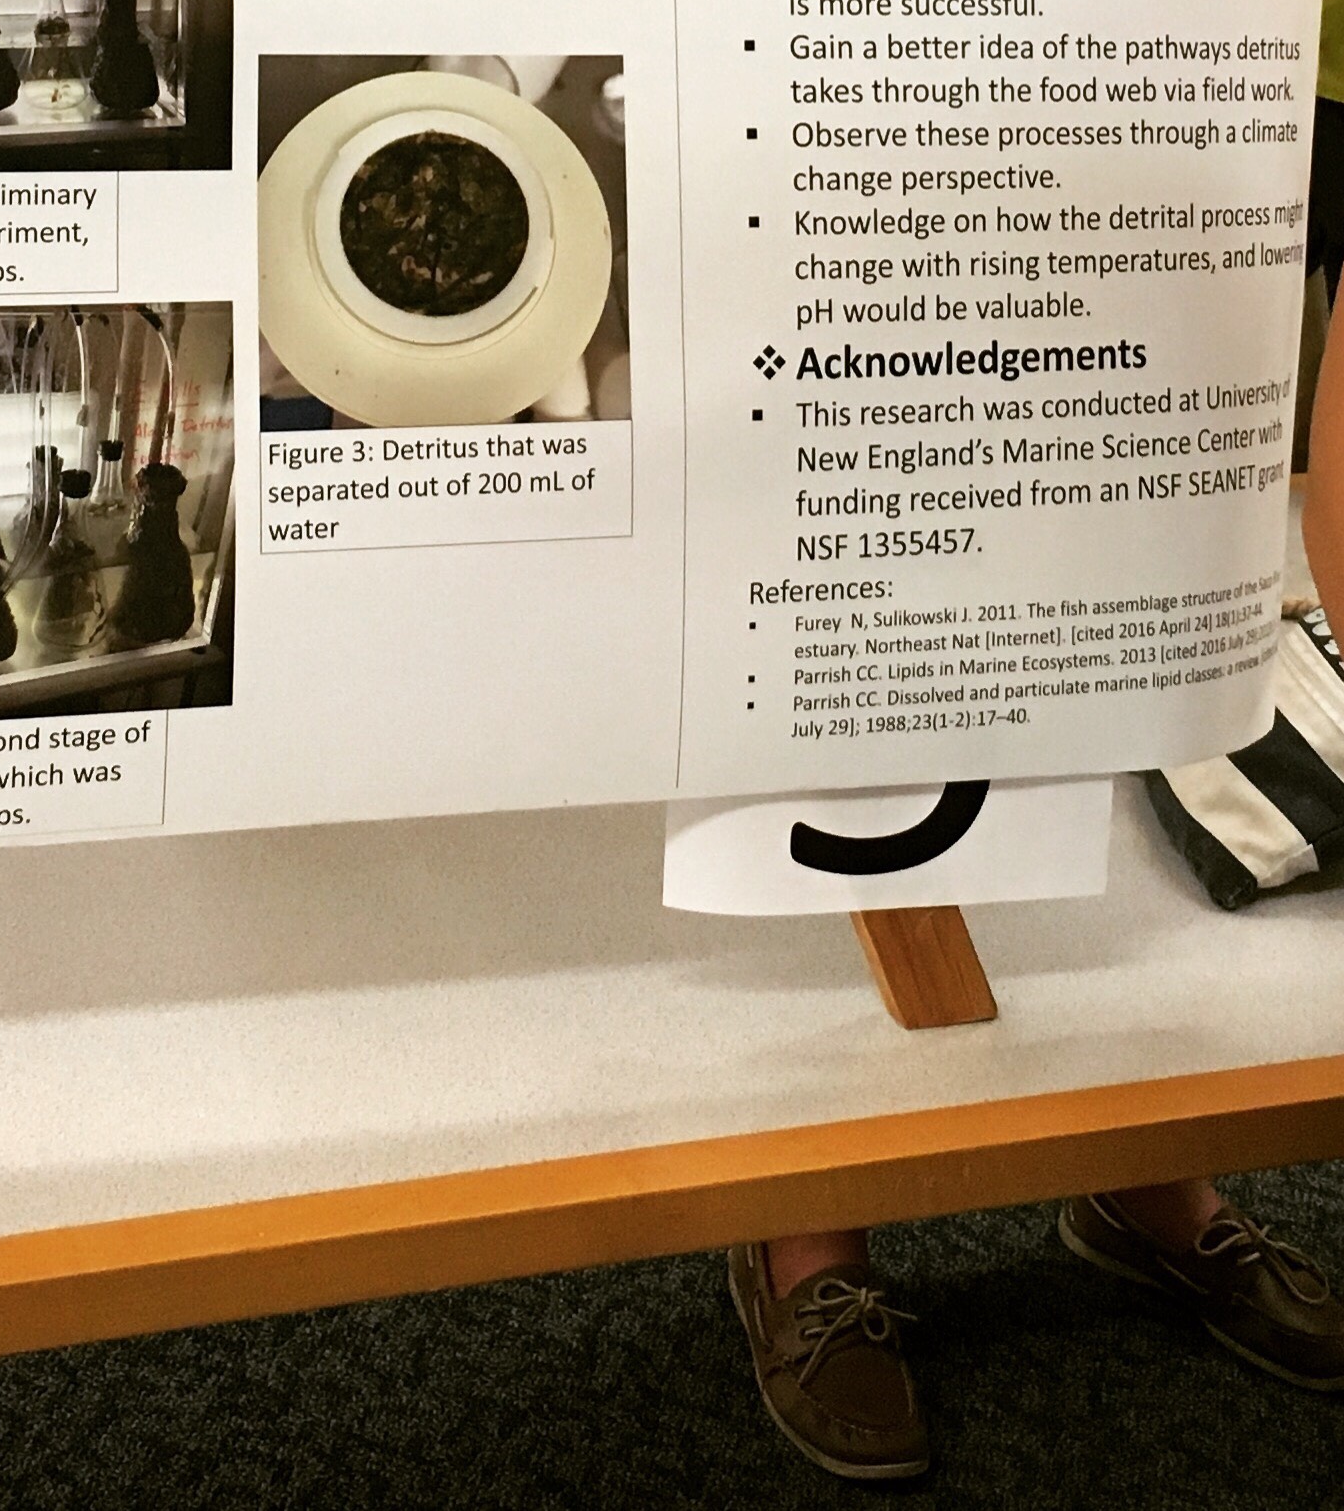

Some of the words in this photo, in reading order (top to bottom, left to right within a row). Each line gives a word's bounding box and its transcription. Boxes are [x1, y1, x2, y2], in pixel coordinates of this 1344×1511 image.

[796, 339, 1147, 382] Acknowledgements
[269, 443, 343, 470] Figure
[352, 441, 373, 462] 3:
[383, 438, 478, 461] Detritus
[486, 435, 534, 457] that
[542, 438, 587, 455] was
[268, 475, 389, 508] separated
[398, 477, 439, 498] out
[447, 472, 471, 496] of
[479, 472, 521, 494] 200
[530, 470, 564, 493] mL
[572, 468, 596, 491] of
[269, 519, 339, 541] water
[798, 534, 848, 562] NSF
[859, 528, 982, 559] 1355457.
[750, 579, 892, 605] References:
[796, 616, 842, 634] Furey
[851, 613, 868, 631] N,
[874, 607, 956, 628] Sulikowski
[961, 607, 972, 623] J.
[978, 604, 1021, 622] 2011.
[1026, 602, 1055, 618] The
[1061, 599, 1087, 616] fish
[1093, 595, 1178, 615] assemblage
[1182, 590, 1232, 608] structure
[795, 643, 859, 659] estuary.
[865, 636, 947, 654] Northeast
[953, 633, 980, 650] Nat
[986, 627, 1066, 651] [Internet].
[1072, 623, 1114, 646] [cited
[1119, 621, 1155, 639] 2016
[1159, 617, 1190, 638] April
[1195, 613, 1212, 633] 24]
[795, 665, 851, 685] Parrish
[857, 665, 882, 682] CC.
[888, 661, 934, 683] Lipids
[940, 661, 954, 676] in
[960, 657, 1017, 675] Marine
[1023, 653, 1114, 673] Ecosystems.
[1120, 647, 1156, 665] 2013
[1161, 642, 1197, 664] [cited
[1200, 638, 1227, 658] 2016
[49, 728, 116, 751] stage
[125, 720, 151, 744] of
[791, 720, 823, 740] July
[828, 717, 860, 737] 29];
